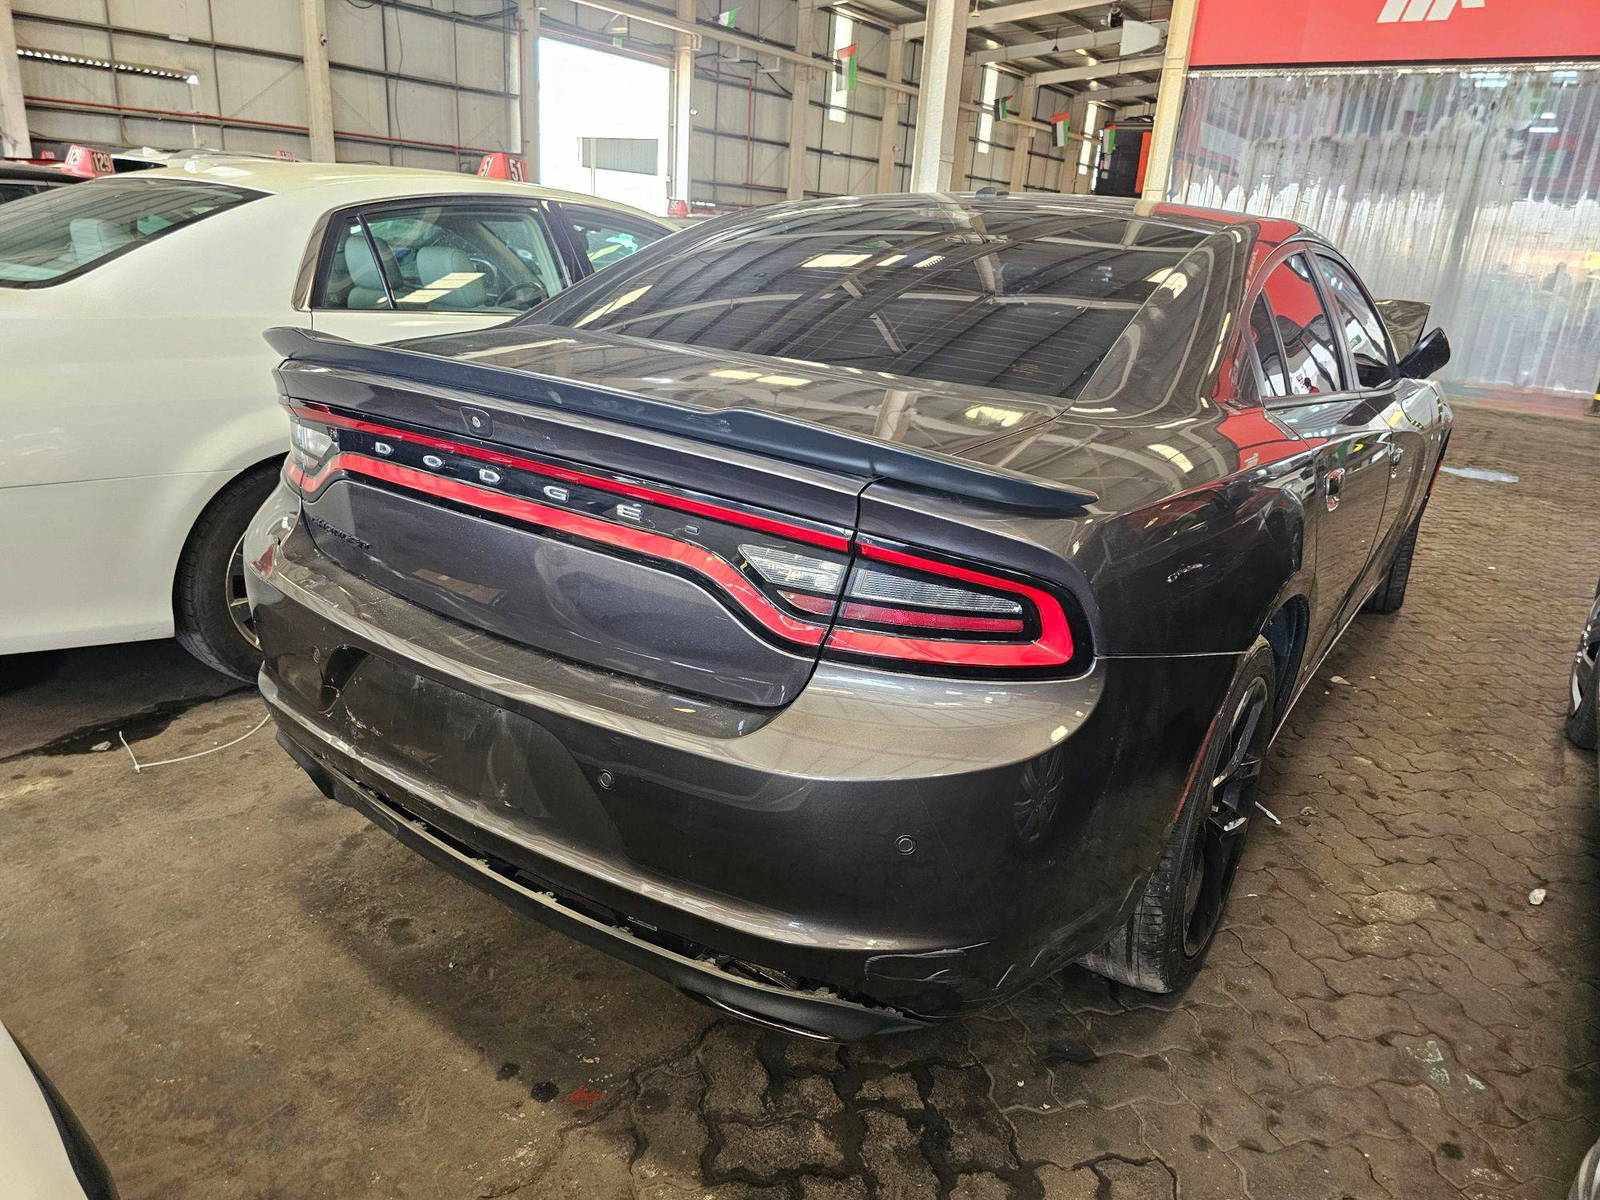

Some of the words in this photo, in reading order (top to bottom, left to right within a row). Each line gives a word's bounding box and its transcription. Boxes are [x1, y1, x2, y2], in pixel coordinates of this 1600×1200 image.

[93, 153, 112, 172] 129
[509, 159, 524, 182] 51
[374, 441, 644, 522] DODGE
